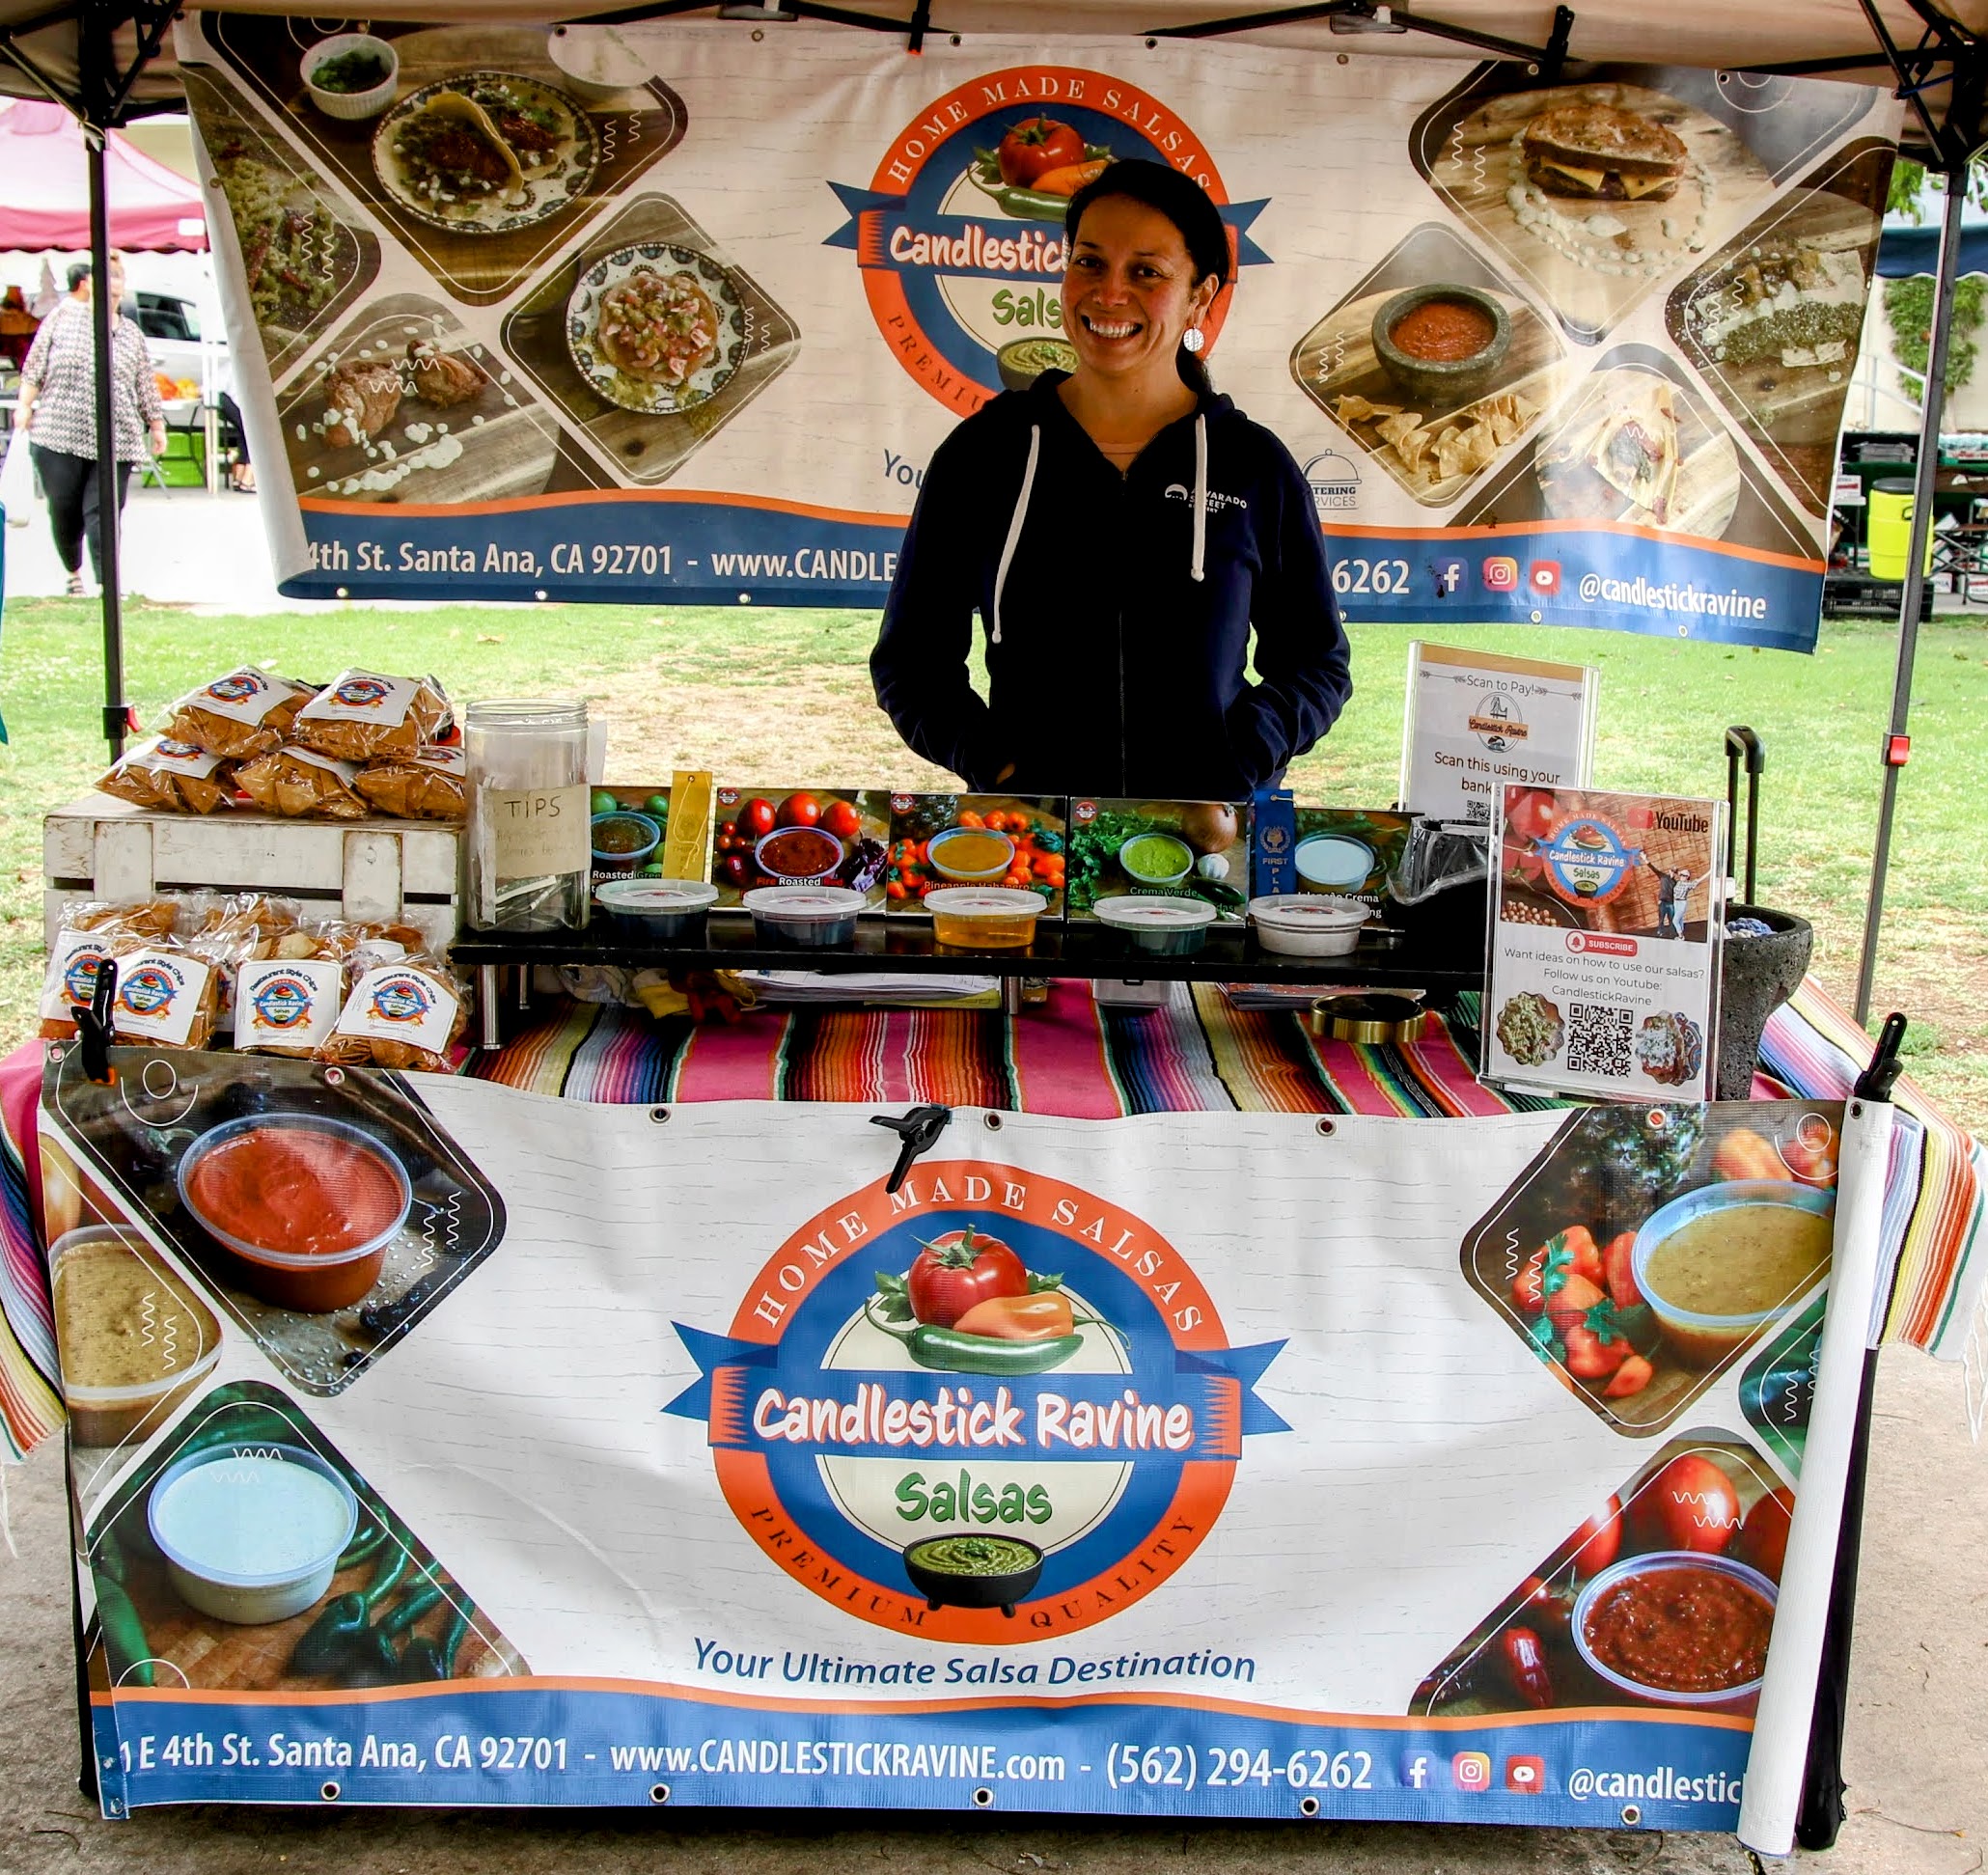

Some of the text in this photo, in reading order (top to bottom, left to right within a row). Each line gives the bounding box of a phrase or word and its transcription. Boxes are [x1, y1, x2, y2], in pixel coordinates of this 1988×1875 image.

[888, 76, 1211, 189] HOME MADE SALSAS
[992, 288, 1063, 329] Sals
[888, 311, 981, 411] PREMI
[884, 449, 923, 489] Yo
[1191, 488, 1247, 510] VARADO
[1312, 486, 1356, 495] TERING
[1314, 496, 1356, 507] RVICES
[309, 540, 348, 571] 4th
[356, 541, 392, 572] St.
[399, 542, 476, 573] Santa
[483, 543, 542, 576] Ana,
[551, 544, 583, 574] CA
[592, 545, 671, 575] 92701
[711, 548, 897, 582] www.CANDLE
[1579, 573, 1766, 620] @candlestickravine
[1466, 675, 1535, 698] Scan to Pay!
[1434, 751, 1560, 785] Scan this using your
[504, 795, 561, 818] TIPS
[1655, 811, 1709, 834] YouTube
[1262, 857, 1288, 866] FIRST
[1549, 849, 1625, 868] Candlestick Ravine
[592, 870, 634, 880] Roasted
[757, 876, 776, 886] Fire
[779, 876, 821, 887] Roasted
[1573, 867, 1600, 879] Salsas
[1130, 886, 1198, 897] Crema Verde
[1344, 893, 1379, 903] Crema
[1588, 939, 1634, 952] SUBSCRIBE
[1505, 947, 1704, 979] Want ideas on how to use our salsas?
[1544, 968, 1662, 991] Follow us on Youtube:
[1552, 984, 1652, 1006] CandlestickRavine
[753, 1174, 1203, 1334] HOME MADE SALSAS
[752, 1383, 1193, 1450] Candlestick Ravine
[895, 1468, 1053, 1525] Salsas
[750, 1505, 1196, 1629] PREMIUM QUALITY
[694, 1636, 1256, 1686] Your Ultimate Salsa Destination
[140, 1735, 155, 1769] E
[162, 1732, 213, 1766] 4th
[222, 1733, 260, 1766] St.
[268, 1733, 352, 1768] Santa
[359, 1735, 428, 1773] Ana,
[434, 1735, 472, 1770] CA
[481, 1737, 567, 1772] 92701
[610, 1738, 1065, 1780] www.CANDLESTICKRAVINE.com
[1105, 1742, 1198, 1792] (562)
[1206, 1748, 1372, 1790] 294-6262
[1568, 1767, 1745, 1805] @candlestic
